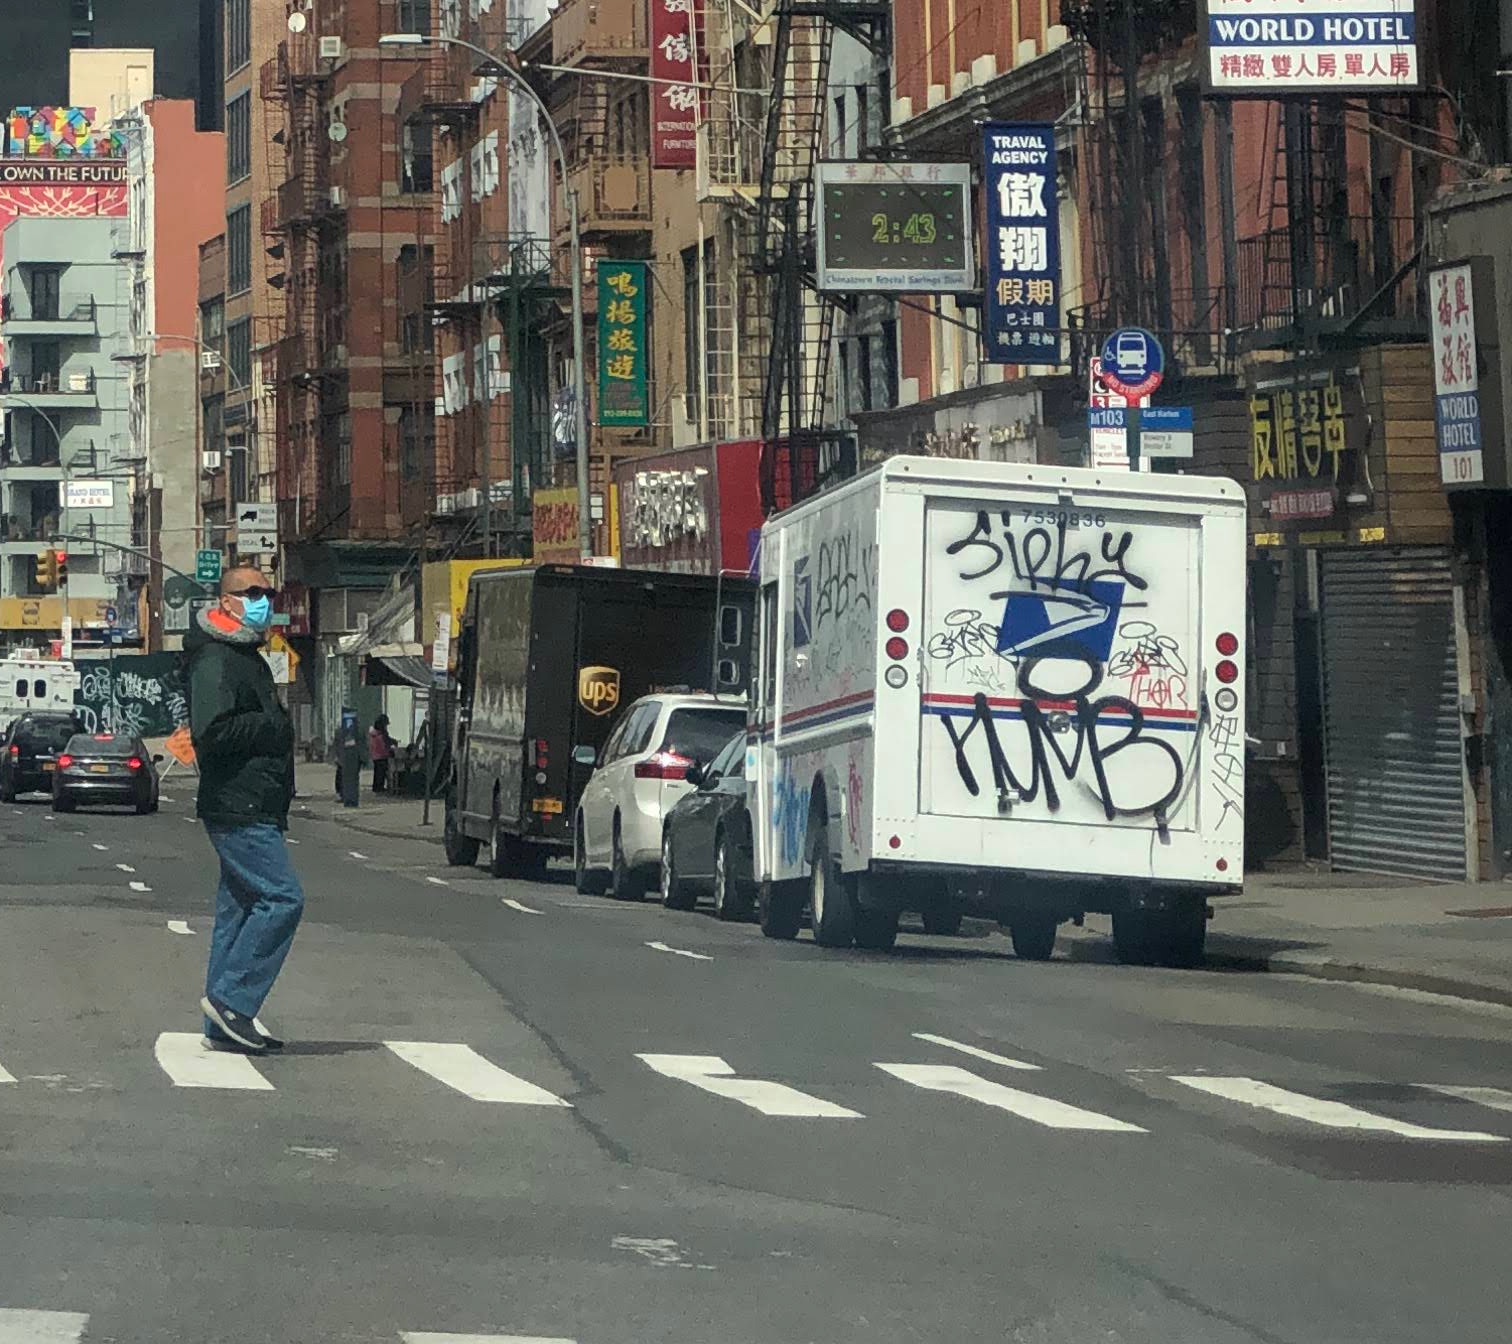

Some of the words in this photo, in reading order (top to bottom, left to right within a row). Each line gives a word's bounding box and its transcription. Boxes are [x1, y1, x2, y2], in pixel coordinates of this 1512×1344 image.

[1215, 18, 1315, 42] WORLD
[1323, 17, 1410, 41] HOTEL
[992, 135, 1046, 149] TRAVAL
[991, 150, 1048, 164] AGENCY
[3, 165, 44, 182] OWN
[48, 166, 78, 181] THE
[81, 166, 128, 181] FUTUR
[871, 212, 937, 244] 2:43
[996, 278, 1055, 306] 假期
[1090, 410, 1124, 426] M103
[1440, 395, 1479, 421] WORLD
[1443, 422, 1477, 447] HOTEL
[1453, 457, 1473, 480] 101
[583, 680, 618, 708] ups
